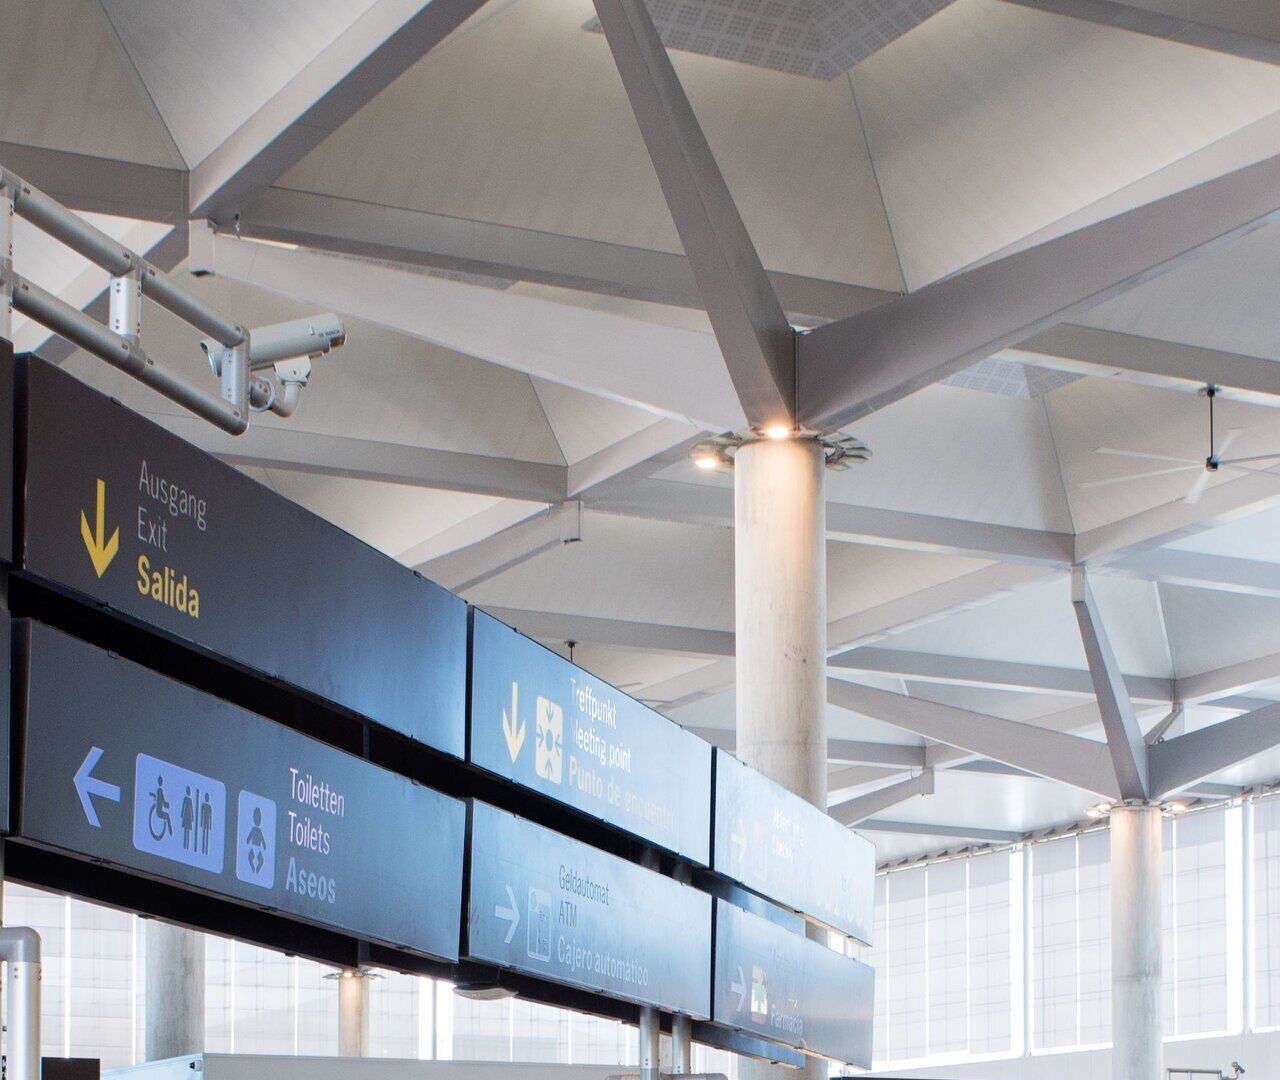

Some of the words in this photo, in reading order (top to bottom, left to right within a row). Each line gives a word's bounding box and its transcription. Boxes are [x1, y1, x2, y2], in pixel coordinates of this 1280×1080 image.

[138, 459, 207, 530] Ausgang
[137, 506, 168, 553] Exit
[136, 555, 200, 619] Salida
[570, 677, 617, 730] Treffpunkt
[569, 755, 602, 799] Punto
[608, 774, 620, 807] de
[609, 743, 632, 774] point
[289, 767, 346, 818] Toiletten
[288, 811, 331, 856] Toilets
[285, 857, 336, 904] Aseos
[559, 864, 609, 906] Geldautomat
[558, 900, 577, 928] ATM
[558, 936, 592, 972] Cajero
